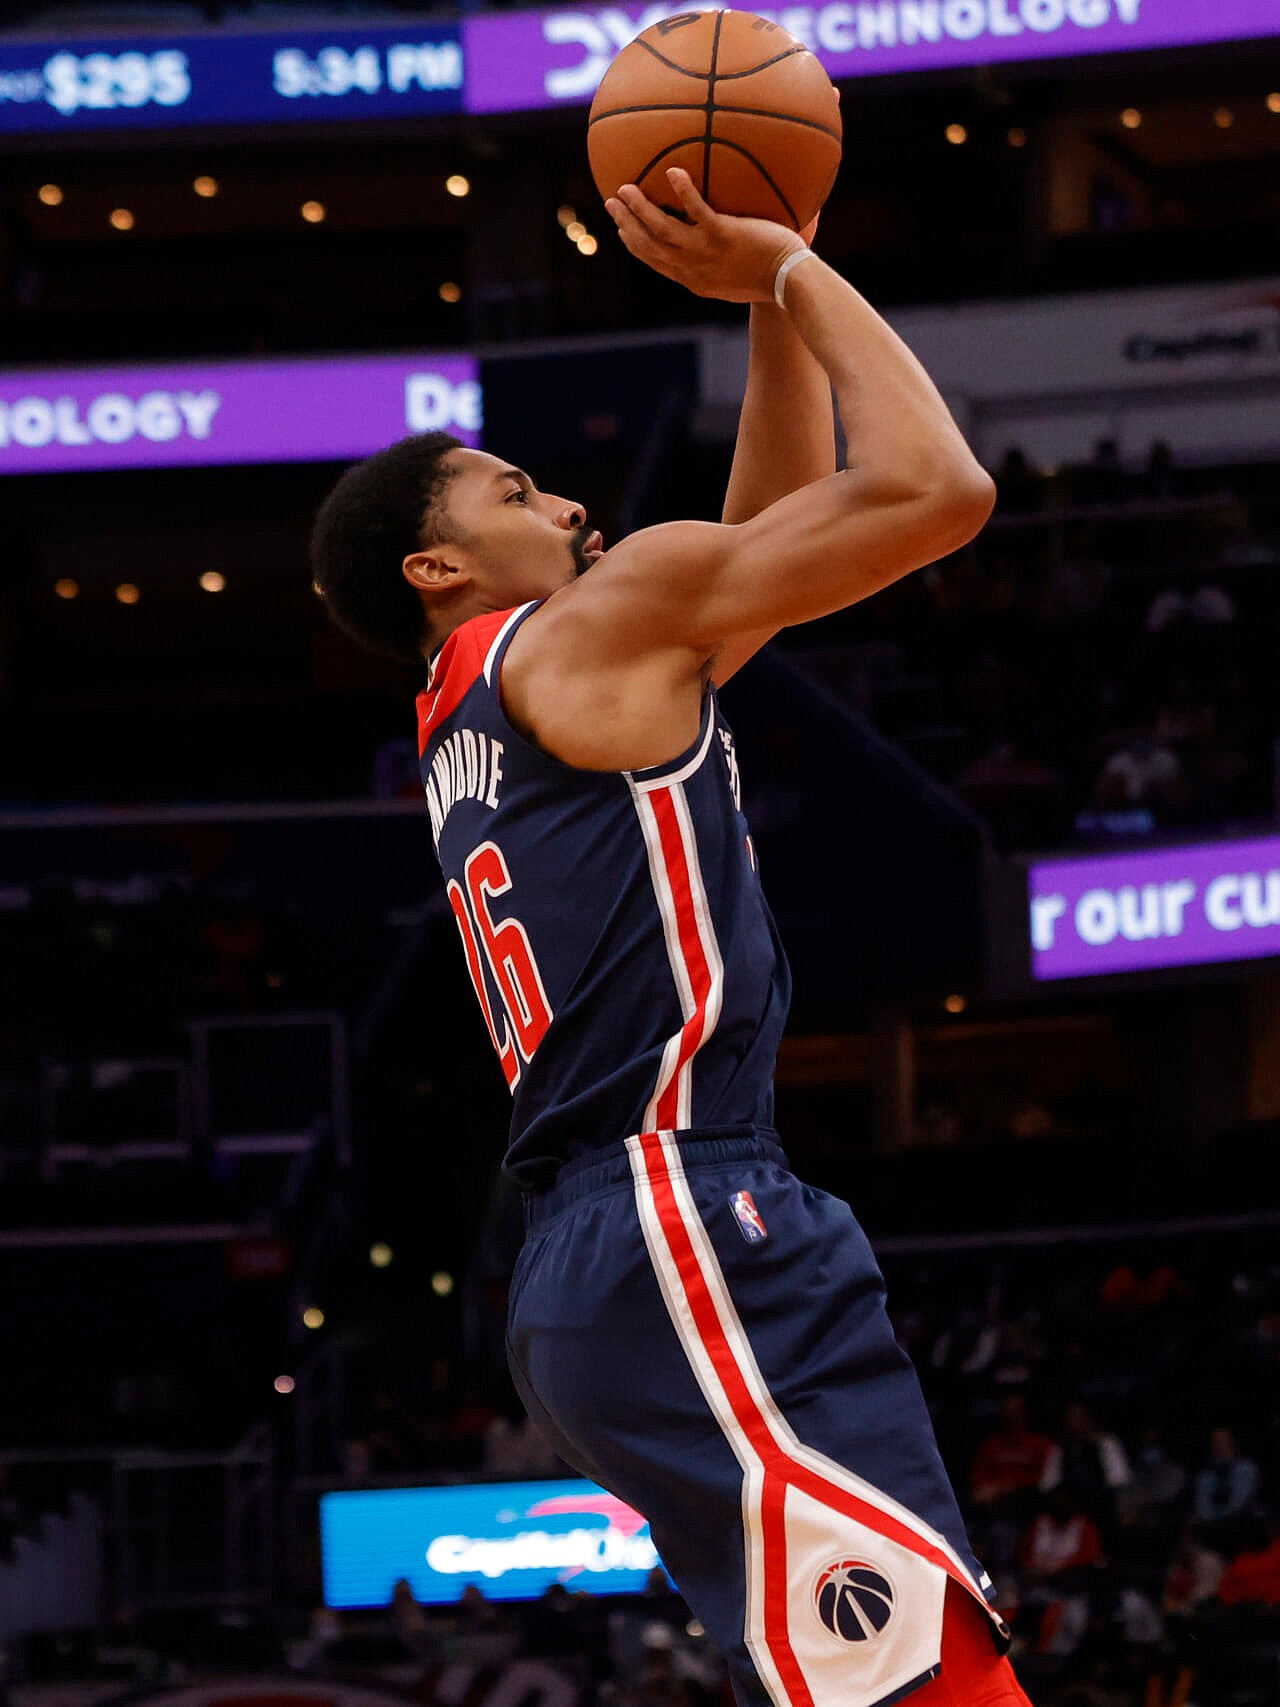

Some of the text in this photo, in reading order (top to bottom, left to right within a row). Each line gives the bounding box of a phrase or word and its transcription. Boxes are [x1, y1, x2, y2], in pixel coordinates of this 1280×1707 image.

[757, 0, 1141, 50] ECHNOLOGY
[387, 41, 463, 93] PM
[1075, 880, 1195, 945] our
